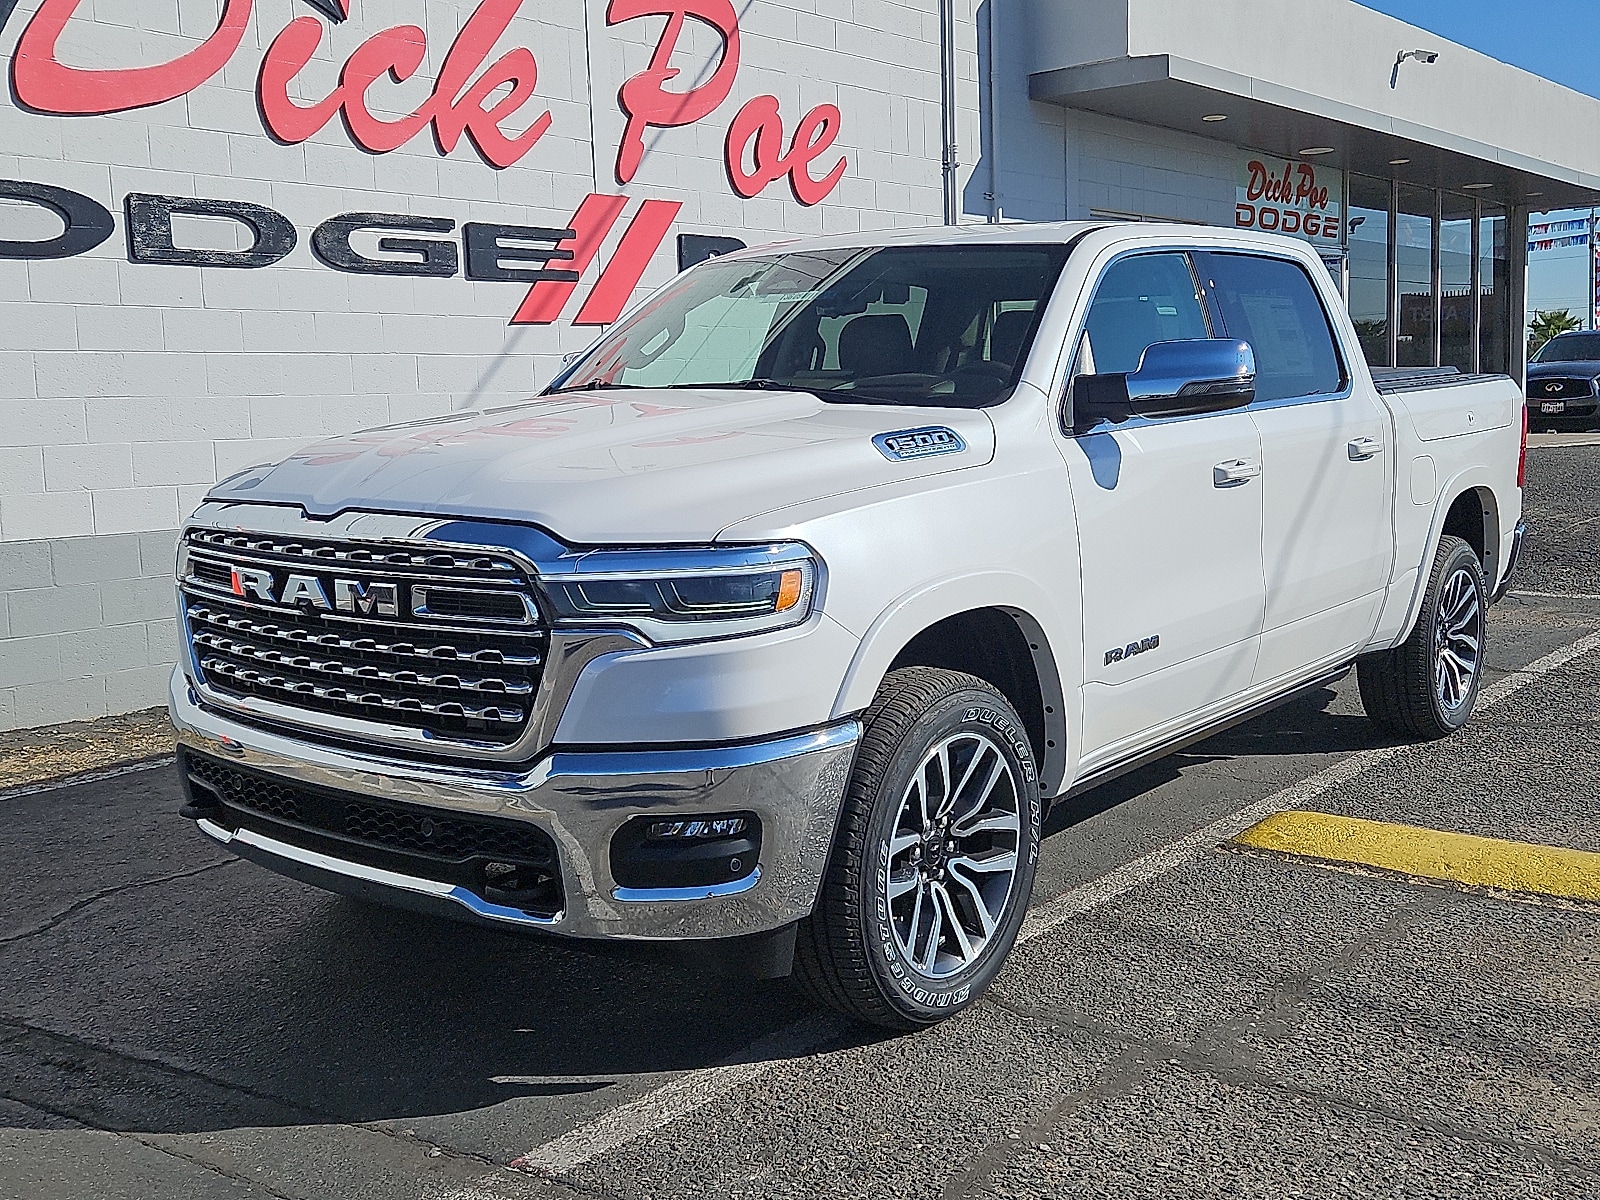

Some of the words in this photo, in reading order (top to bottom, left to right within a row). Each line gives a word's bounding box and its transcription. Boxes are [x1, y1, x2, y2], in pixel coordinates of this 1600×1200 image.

[604, 0, 848, 207] Poe
[1246, 160, 1293, 205] Dick
[1294, 163, 1329, 210] Poe
[1235, 202, 1340, 239] DODGE
[886, 432, 950, 453] 1500
[230, 565, 399, 617] RAM
[1103, 634, 1160, 667] RAM
[961, 707, 1036, 783] DUELER
[875, 838, 972, 1008] BRIDGESTONE
